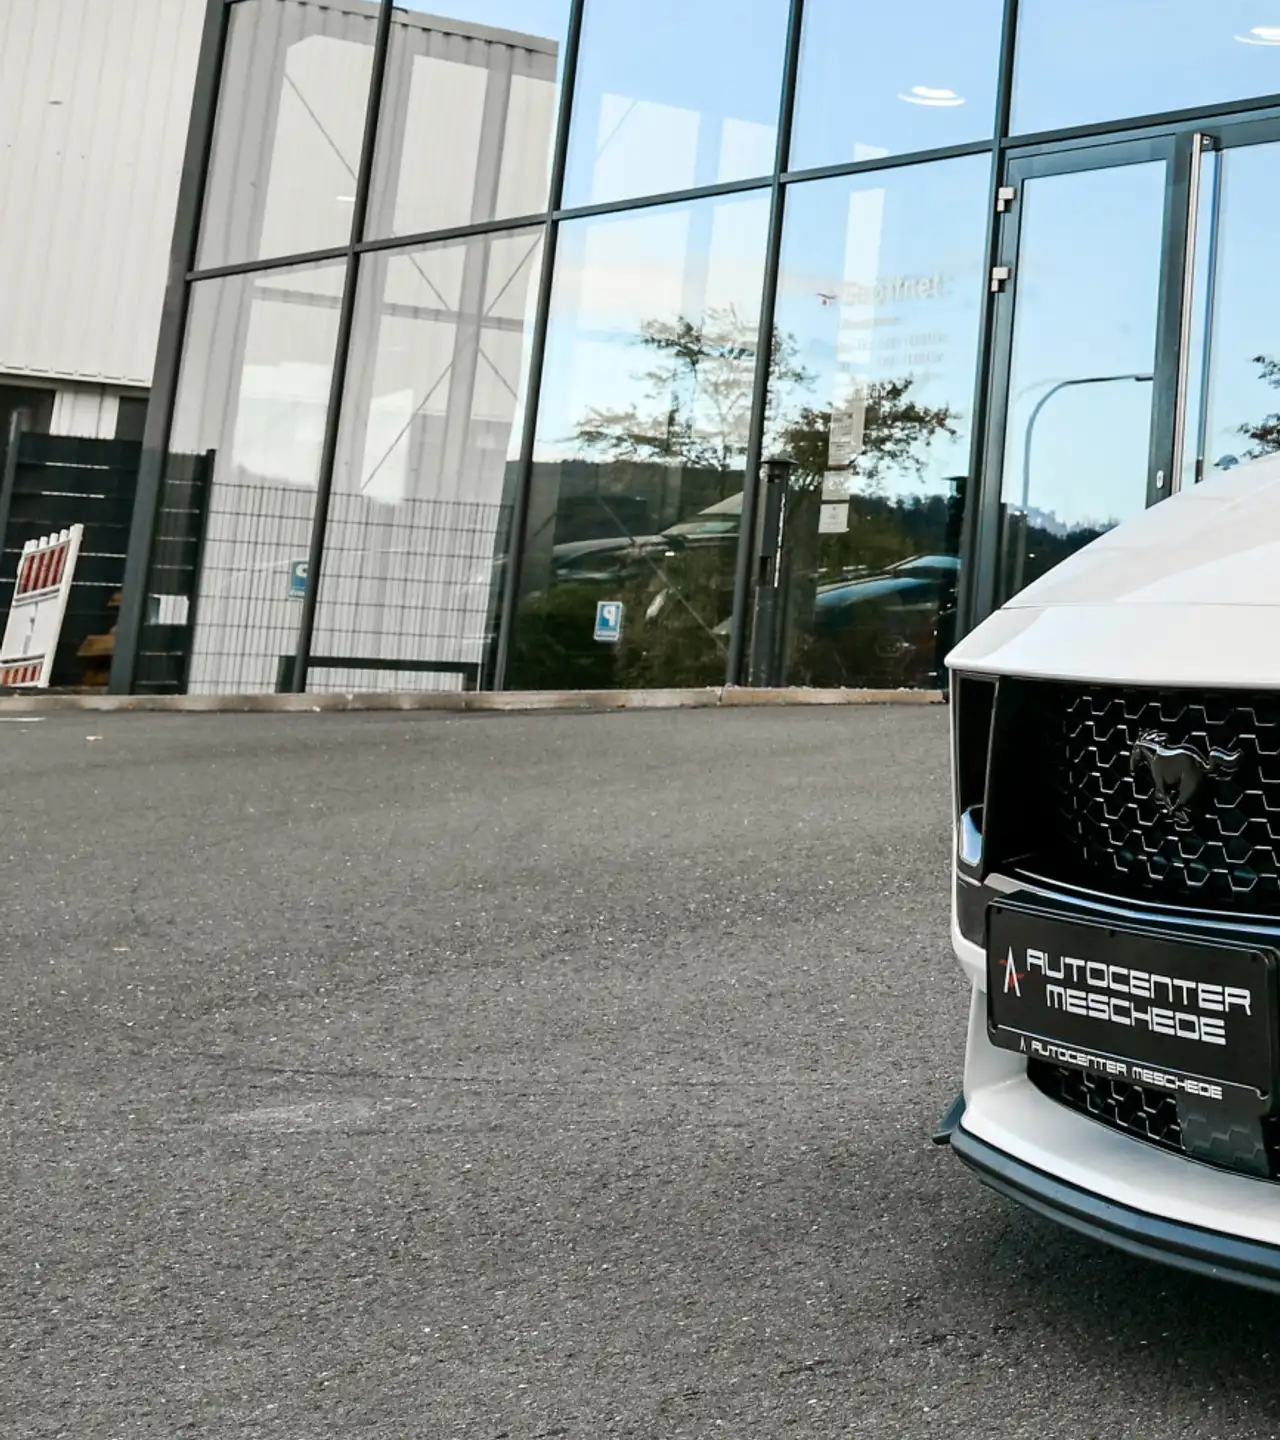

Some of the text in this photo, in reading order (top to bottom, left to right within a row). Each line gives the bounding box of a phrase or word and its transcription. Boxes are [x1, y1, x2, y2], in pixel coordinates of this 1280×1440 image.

[1026, 948, 1252, 1016] AUTOCENTER
[1046, 983, 1227, 1046] MESCHEDE
[1031, 1039, 1223, 1100] AUTOCENTER MESCHEDE
